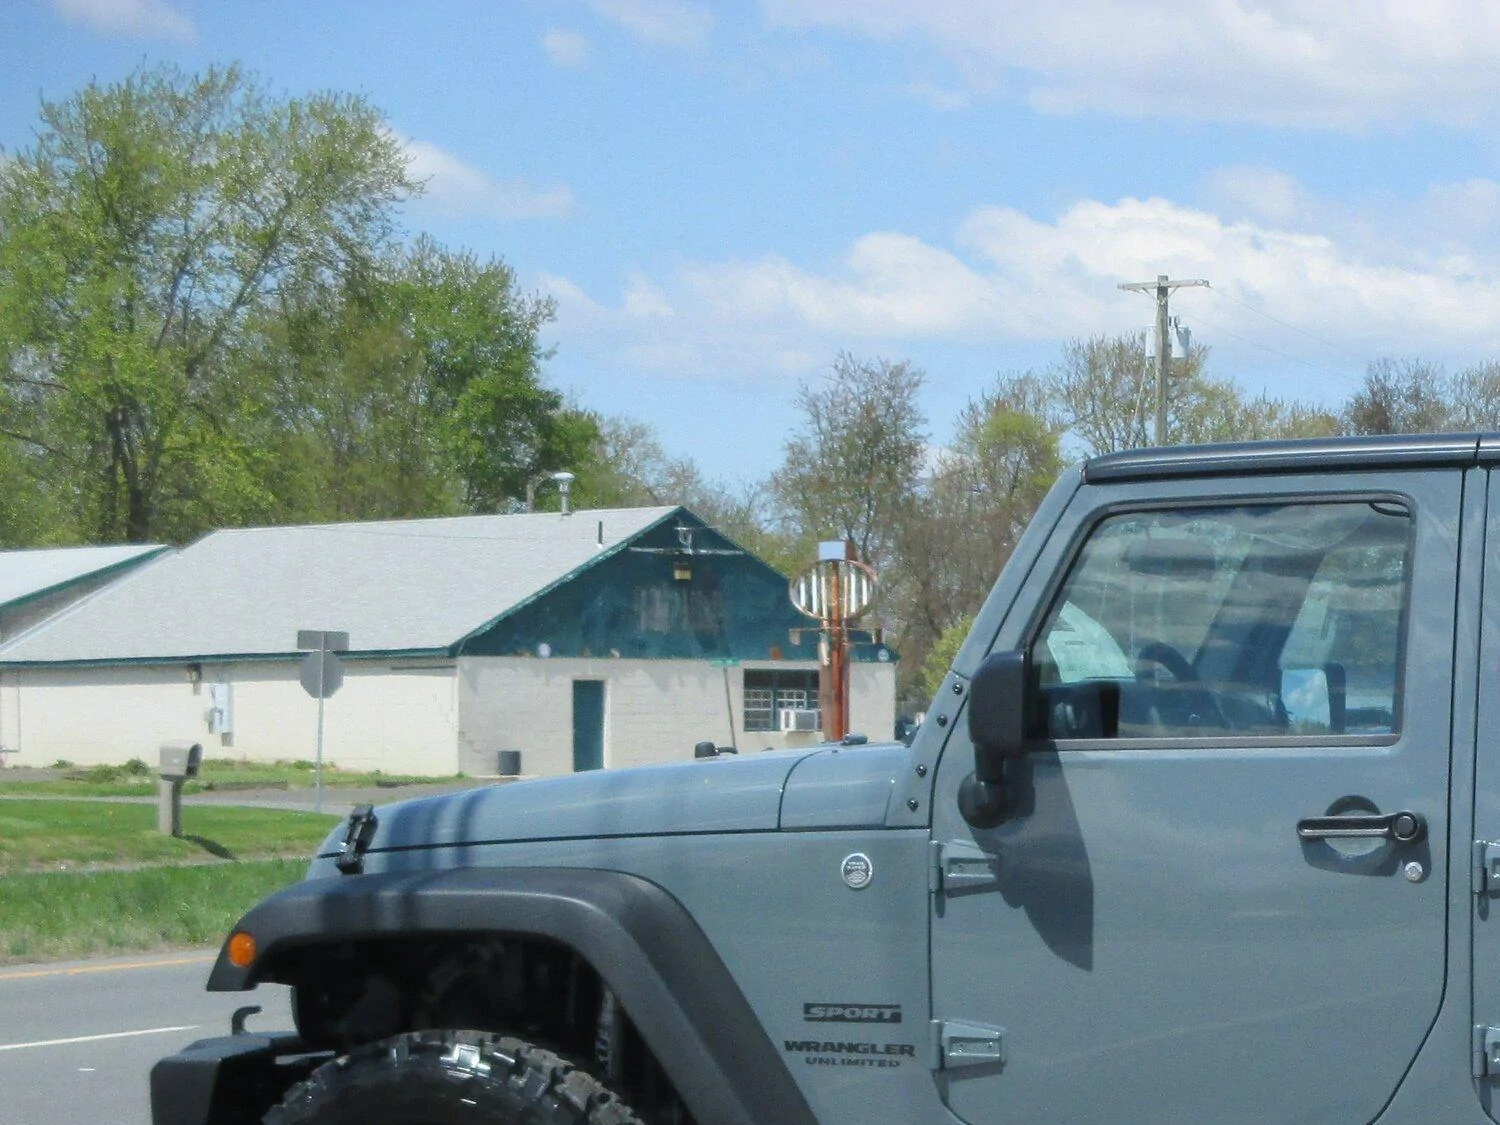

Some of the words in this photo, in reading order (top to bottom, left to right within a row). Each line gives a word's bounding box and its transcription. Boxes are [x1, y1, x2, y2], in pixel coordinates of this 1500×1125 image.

[807, 1005, 901, 1020] SPORT
[784, 1040, 916, 1057] WRANGLER
[805, 1057, 900, 1067] UNLIMITED
